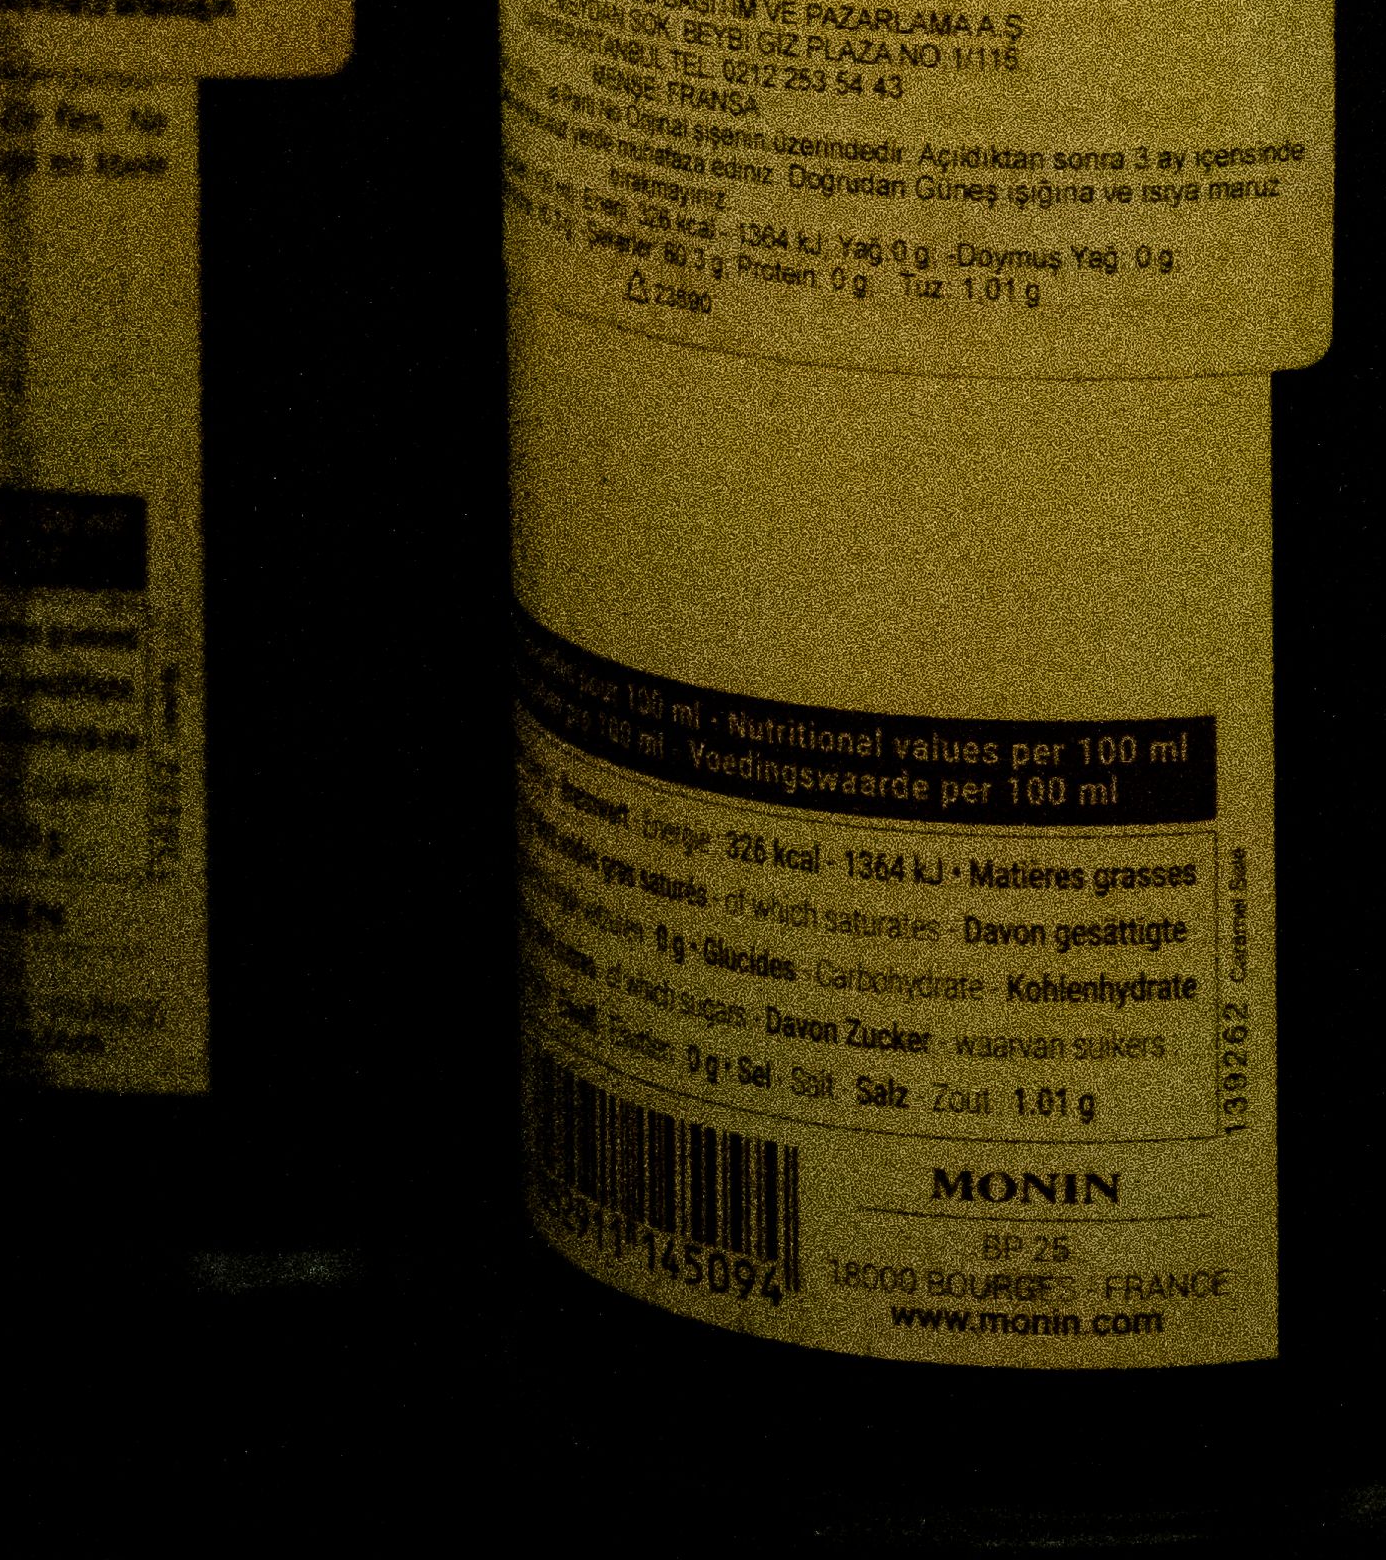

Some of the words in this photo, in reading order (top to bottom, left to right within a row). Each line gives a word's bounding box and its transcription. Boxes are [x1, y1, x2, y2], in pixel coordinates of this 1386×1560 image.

[764, 0, 798, 25] VE
[805, 3, 977, 37] PAZARLAMA
[806, 35, 892, 66] PLAZA
[667, 81, 761, 118] FRANSA
[723, 58, 776, 89] 0212
[836, 74, 863, 96] 54
[873, 76, 905, 100] 43
[1053, 146, 1125, 171] sonra
[1134, 145, 1149, 170] 3
[1157, 148, 1186, 177] ay
[787, 163, 907, 200] Doğrudan
[914, 175, 998, 210] Güneş
[1103, 183, 1133, 204] ve
[1207, 175, 1282, 202] maruz
[891, 239, 907, 263] 0
[1135, 244, 1151, 268] 0
[1158, 248, 1175, 275] g
[829, 267, 846, 292] 0
[964, 277, 1014, 304] 1.01
[1024, 281, 1041, 309] g
[671, 699, 701, 731] ml
[727, 711, 883, 758] Nutritional
[894, 732, 1000, 766] values
[1010, 740, 1066, 770] per
[1078, 735, 1138, 766] 100
[1149, 730, 1190, 763] ml
[688, 739, 930, 796] Voedingswaarde
[940, 780, 993, 809] per
[1009, 775, 1066, 806] 100
[1078, 774, 1118, 805] ml
[725, 829, 766, 863] 326
[772, 840, 821, 873] kcal
[844, 850, 905, 882] 1364
[914, 853, 944, 886] kJ
[970, 857, 1086, 891] Matières
[1093, 861, 1197, 897] grasses
[753, 896, 818, 929] which
[824, 905, 941, 942] saturates
[964, 914, 1045, 948] Davon
[1054, 916, 1188, 953] gesättigte
[703, 936, 796, 982] Glucides
[814, 958, 984, 1002] Carbohydrate
[1006, 972, 1198, 1009] Kohlenhydrate
[765, 1006, 838, 1044] Davon
[846, 1018, 932, 1054] Zucker
[955, 1033, 1064, 1060] waarvan
[1072, 1031, 1166, 1061] suikers
[737, 1055, 772, 1089] Sel
[790, 1065, 835, 1099] Salt
[856, 1075, 910, 1110] Salz
[931, 1081, 992, 1116] Zout
[1014, 1086, 1067, 1117] 1.01
[1078, 1091, 1098, 1124] g
[1222, 1002, 1251, 1136] 139262
[929, 1167, 1121, 1205] MONIN
[640, 1230, 784, 1308] 145094
[982, 1234, 1023, 1262] BP
[1033, 1235, 1070, 1263] 25
[827, 1258, 917, 1294] 18000
[927, 1272, 1077, 1302] BOURGES
[1104, 1269, 1230, 1300] FRANCE
[890, 1305, 1164, 1336] www.monin.com
